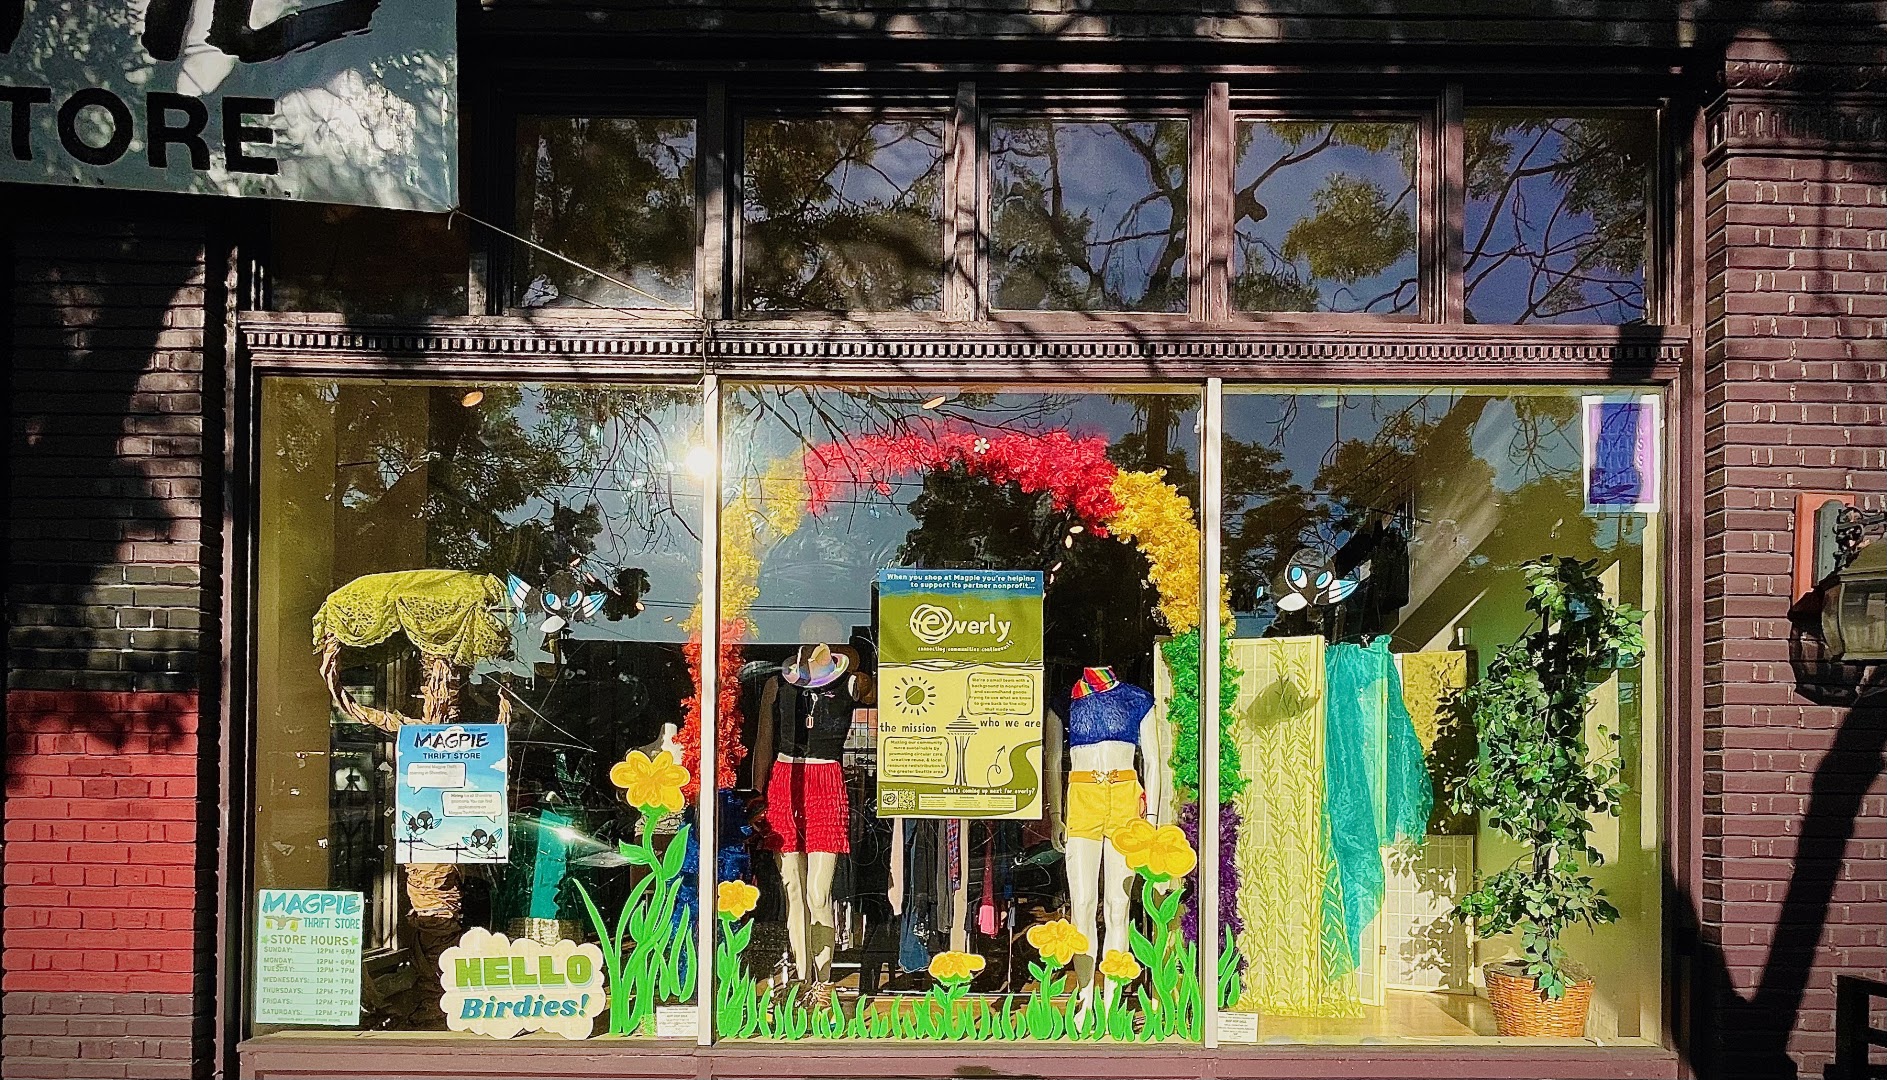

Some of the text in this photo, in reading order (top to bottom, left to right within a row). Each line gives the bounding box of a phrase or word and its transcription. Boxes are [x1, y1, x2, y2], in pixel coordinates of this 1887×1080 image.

[880, 723, 936, 733] the mission
[980, 717, 1000, 727] who
[414, 732, 490, 748] MAGPIE
[262, 891, 360, 915] MAGPIE
[304, 917, 360, 929] THRIFT STORE
[270, 935, 349, 946] STORE HOURS
[455, 955, 593, 988] HELLO
[460, 994, 590, 1019] Birdies!
